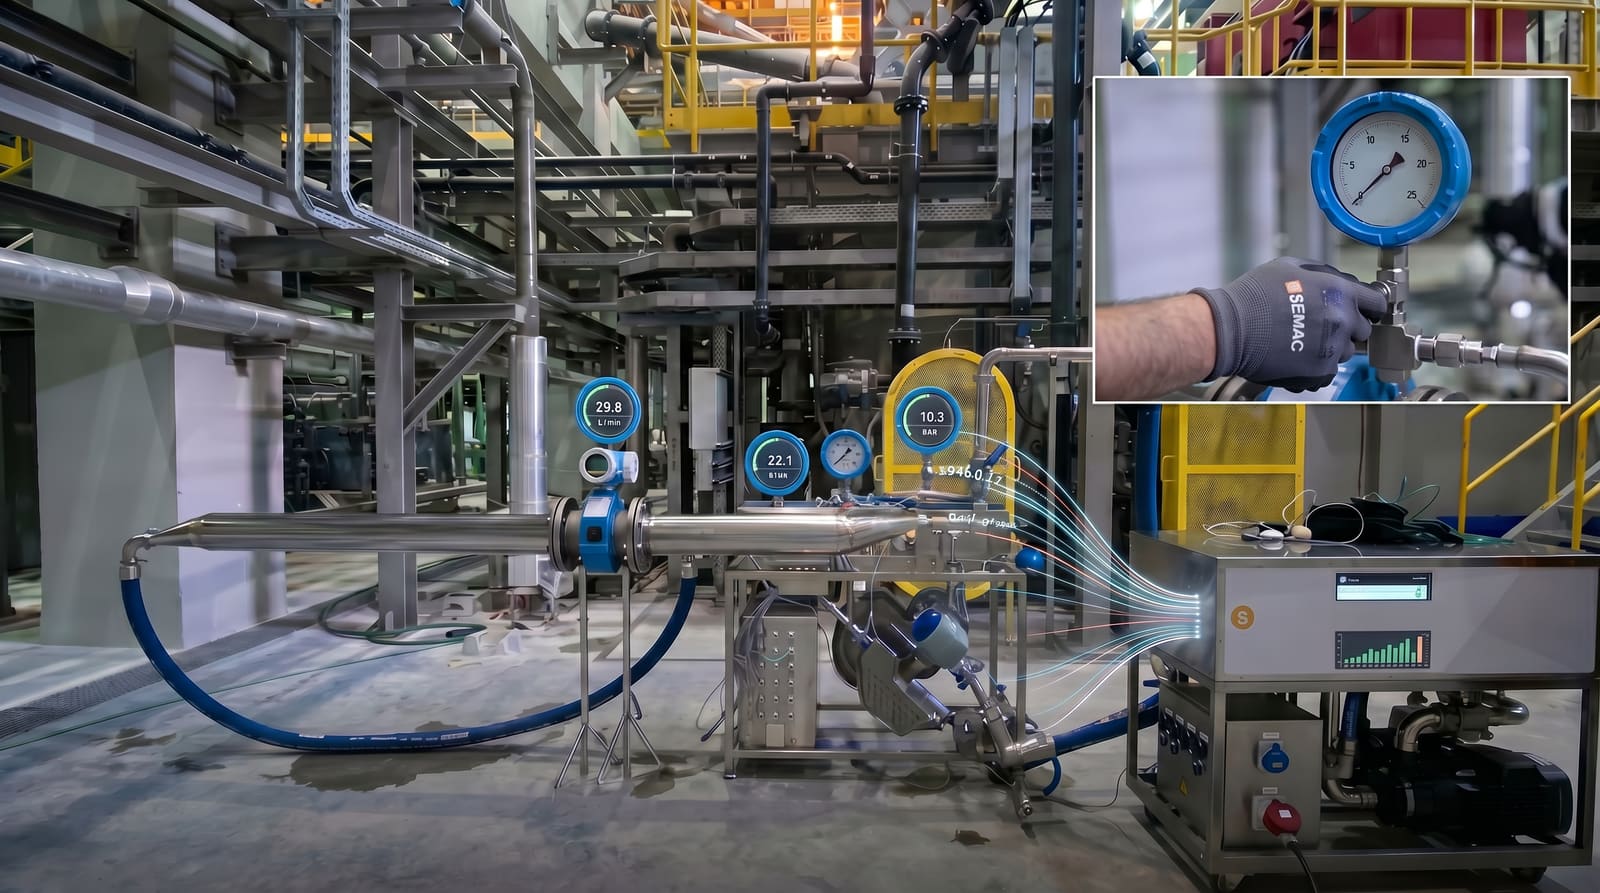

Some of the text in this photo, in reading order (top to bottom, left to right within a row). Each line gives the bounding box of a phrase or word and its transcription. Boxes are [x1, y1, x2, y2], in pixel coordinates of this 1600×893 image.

[1366, 135, 1375, 144] 10
[1401, 134, 1410, 143] 15
[1349, 161, 1355, 170] 5
[1417, 159, 1427, 168] 20
[1407, 190, 1417, 200] 25
[1289, 294, 1306, 352] SEMAC
[596, 401, 622, 413] 29.8
[920, 411, 944, 423] 10.3
[922, 428, 938, 436] BAR
[767, 455, 792, 466] 22.1
[1237, 610, 1249, 625] S
